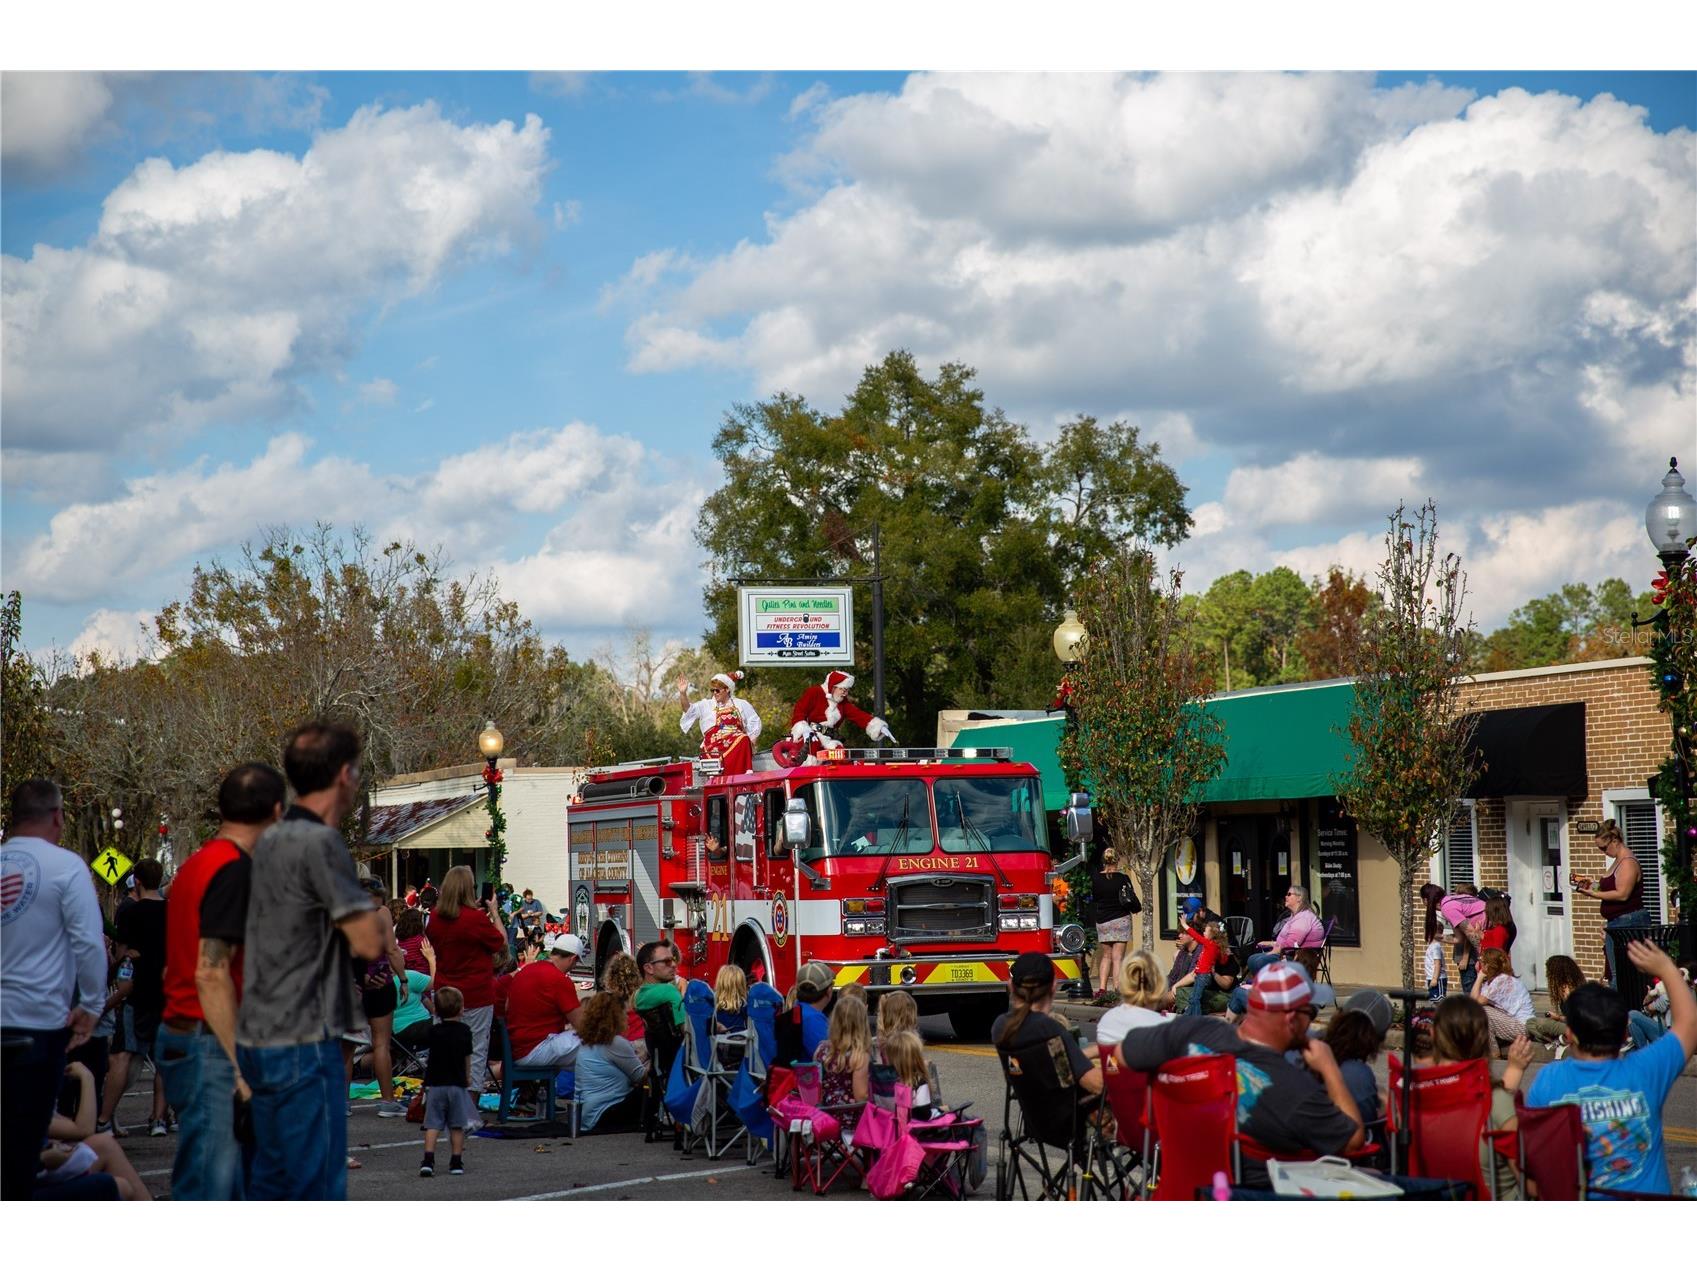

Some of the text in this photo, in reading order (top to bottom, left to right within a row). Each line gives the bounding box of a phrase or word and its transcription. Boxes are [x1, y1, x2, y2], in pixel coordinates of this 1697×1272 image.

[898, 857, 980, 870] ENGINE 21
[711, 865, 727, 876] ENGINE
[711, 892, 729, 941] 21
